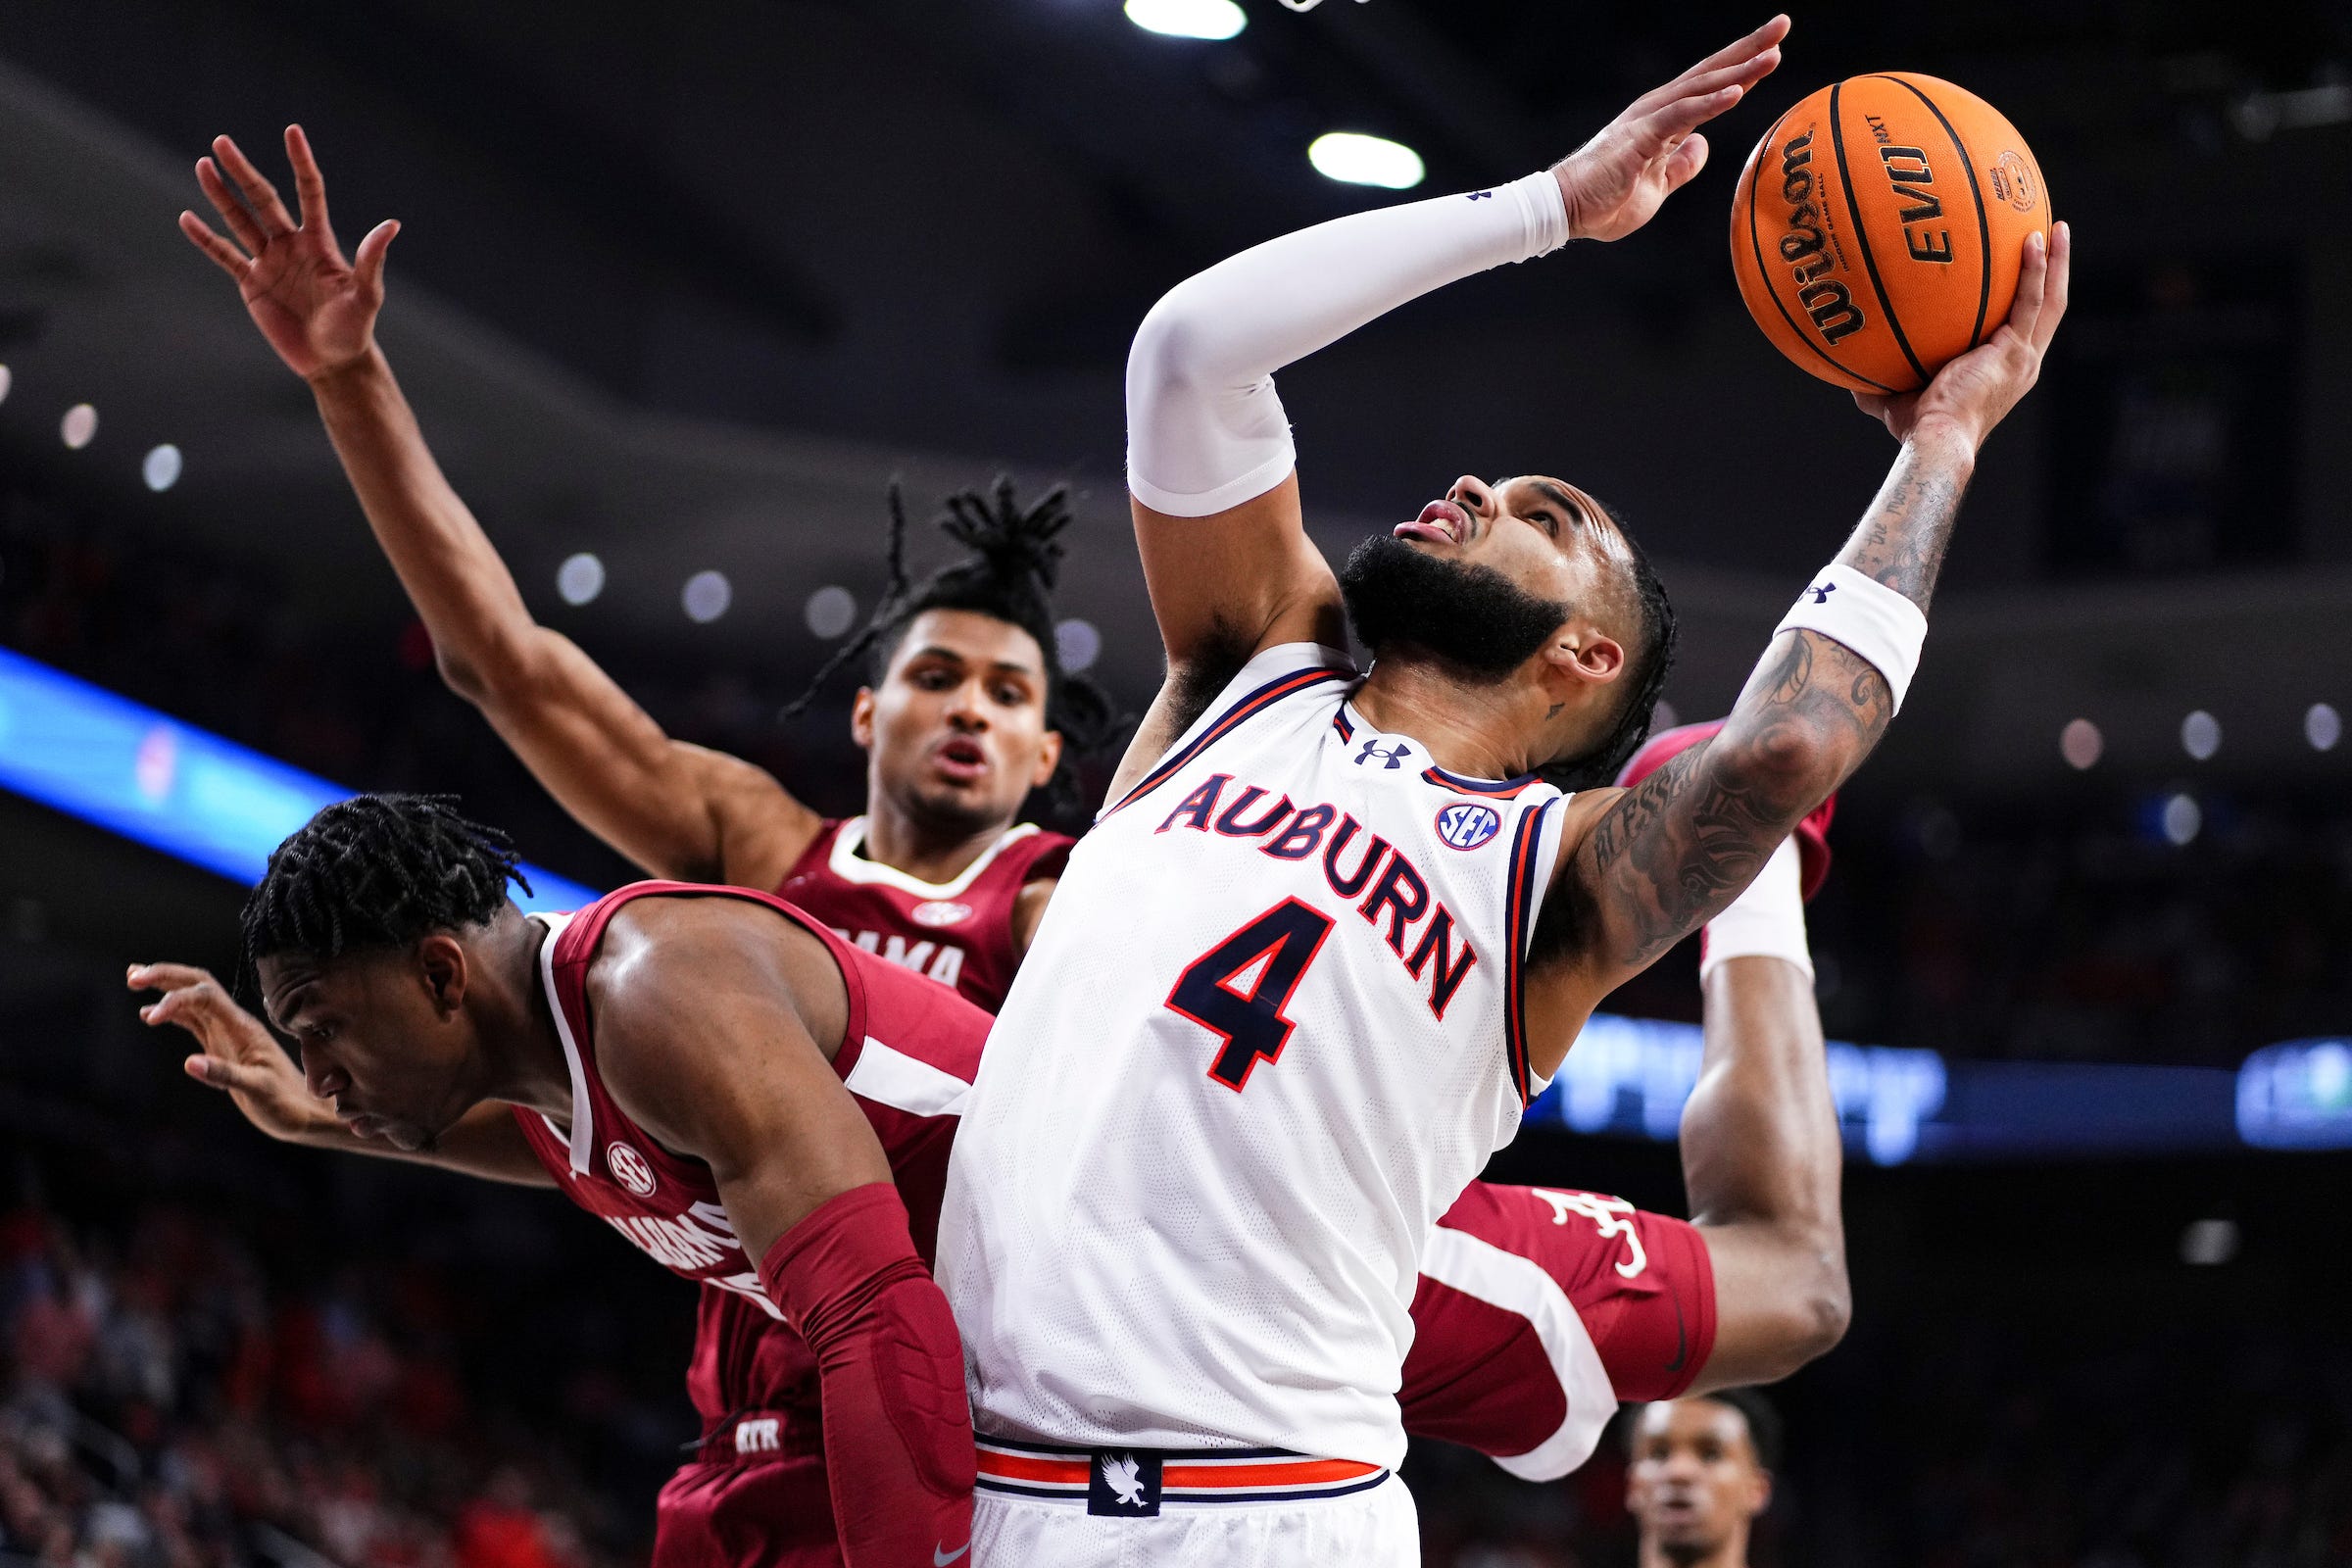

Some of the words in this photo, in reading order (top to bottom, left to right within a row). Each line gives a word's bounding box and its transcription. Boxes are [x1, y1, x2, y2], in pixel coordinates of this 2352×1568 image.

[1817, 172, 1827, 199] BALL
[1879, 144, 1955, 265] EVO
[1778, 127, 1867, 347] Wilson
[1821, 200, 1834, 231] GAME
[1831, 233, 1850, 272] INDOOR
[1438, 804, 1498, 849] SEC
[1153, 772, 1477, 1022] AUBURN
[1163, 895, 1337, 1094] 4
[609, 1144, 656, 1196] SEC
